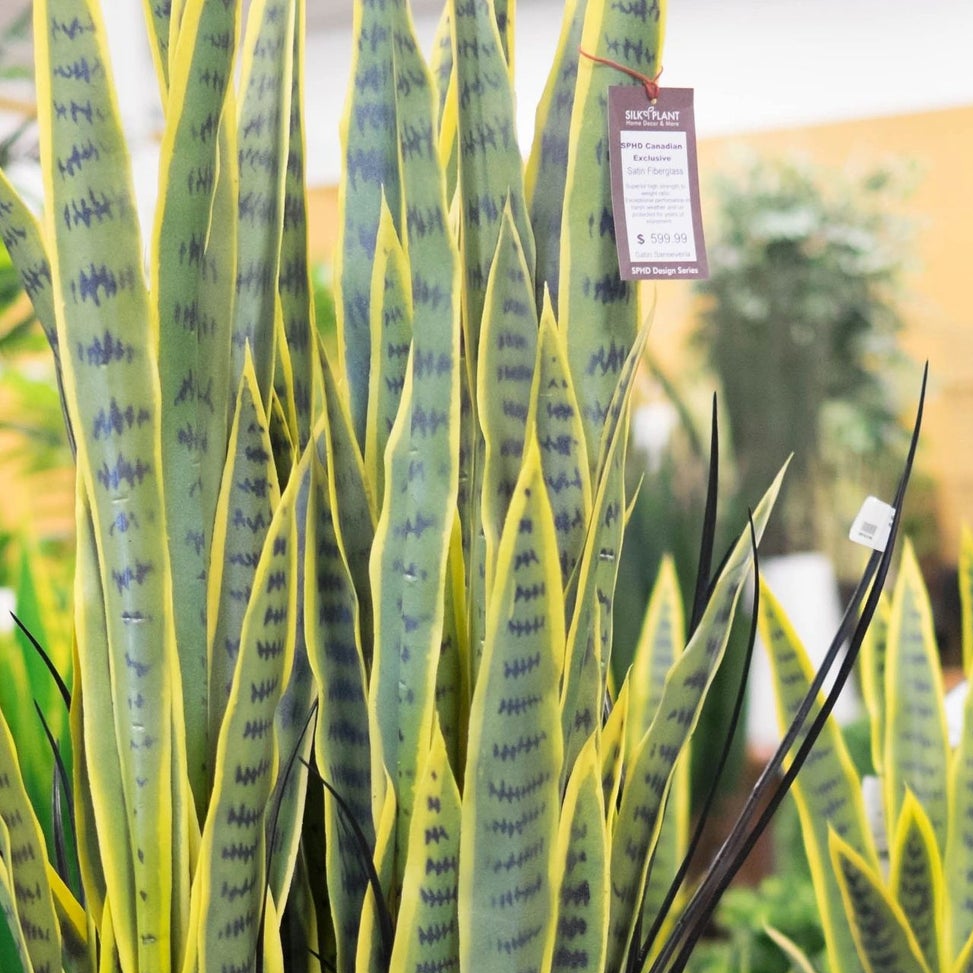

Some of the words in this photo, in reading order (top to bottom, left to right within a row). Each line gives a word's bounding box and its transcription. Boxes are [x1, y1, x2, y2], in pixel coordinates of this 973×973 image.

[625, 110, 643, 120] SILK
[652, 111, 680, 120] PLANT
[645, 142, 683, 150] Canadian
[627, 166, 645, 175] Satin
[647, 166, 684, 176] Fiberglass
[637, 234, 645, 245] $
[651, 233, 687, 244] 599.99
[653, 267, 676, 275] Design
